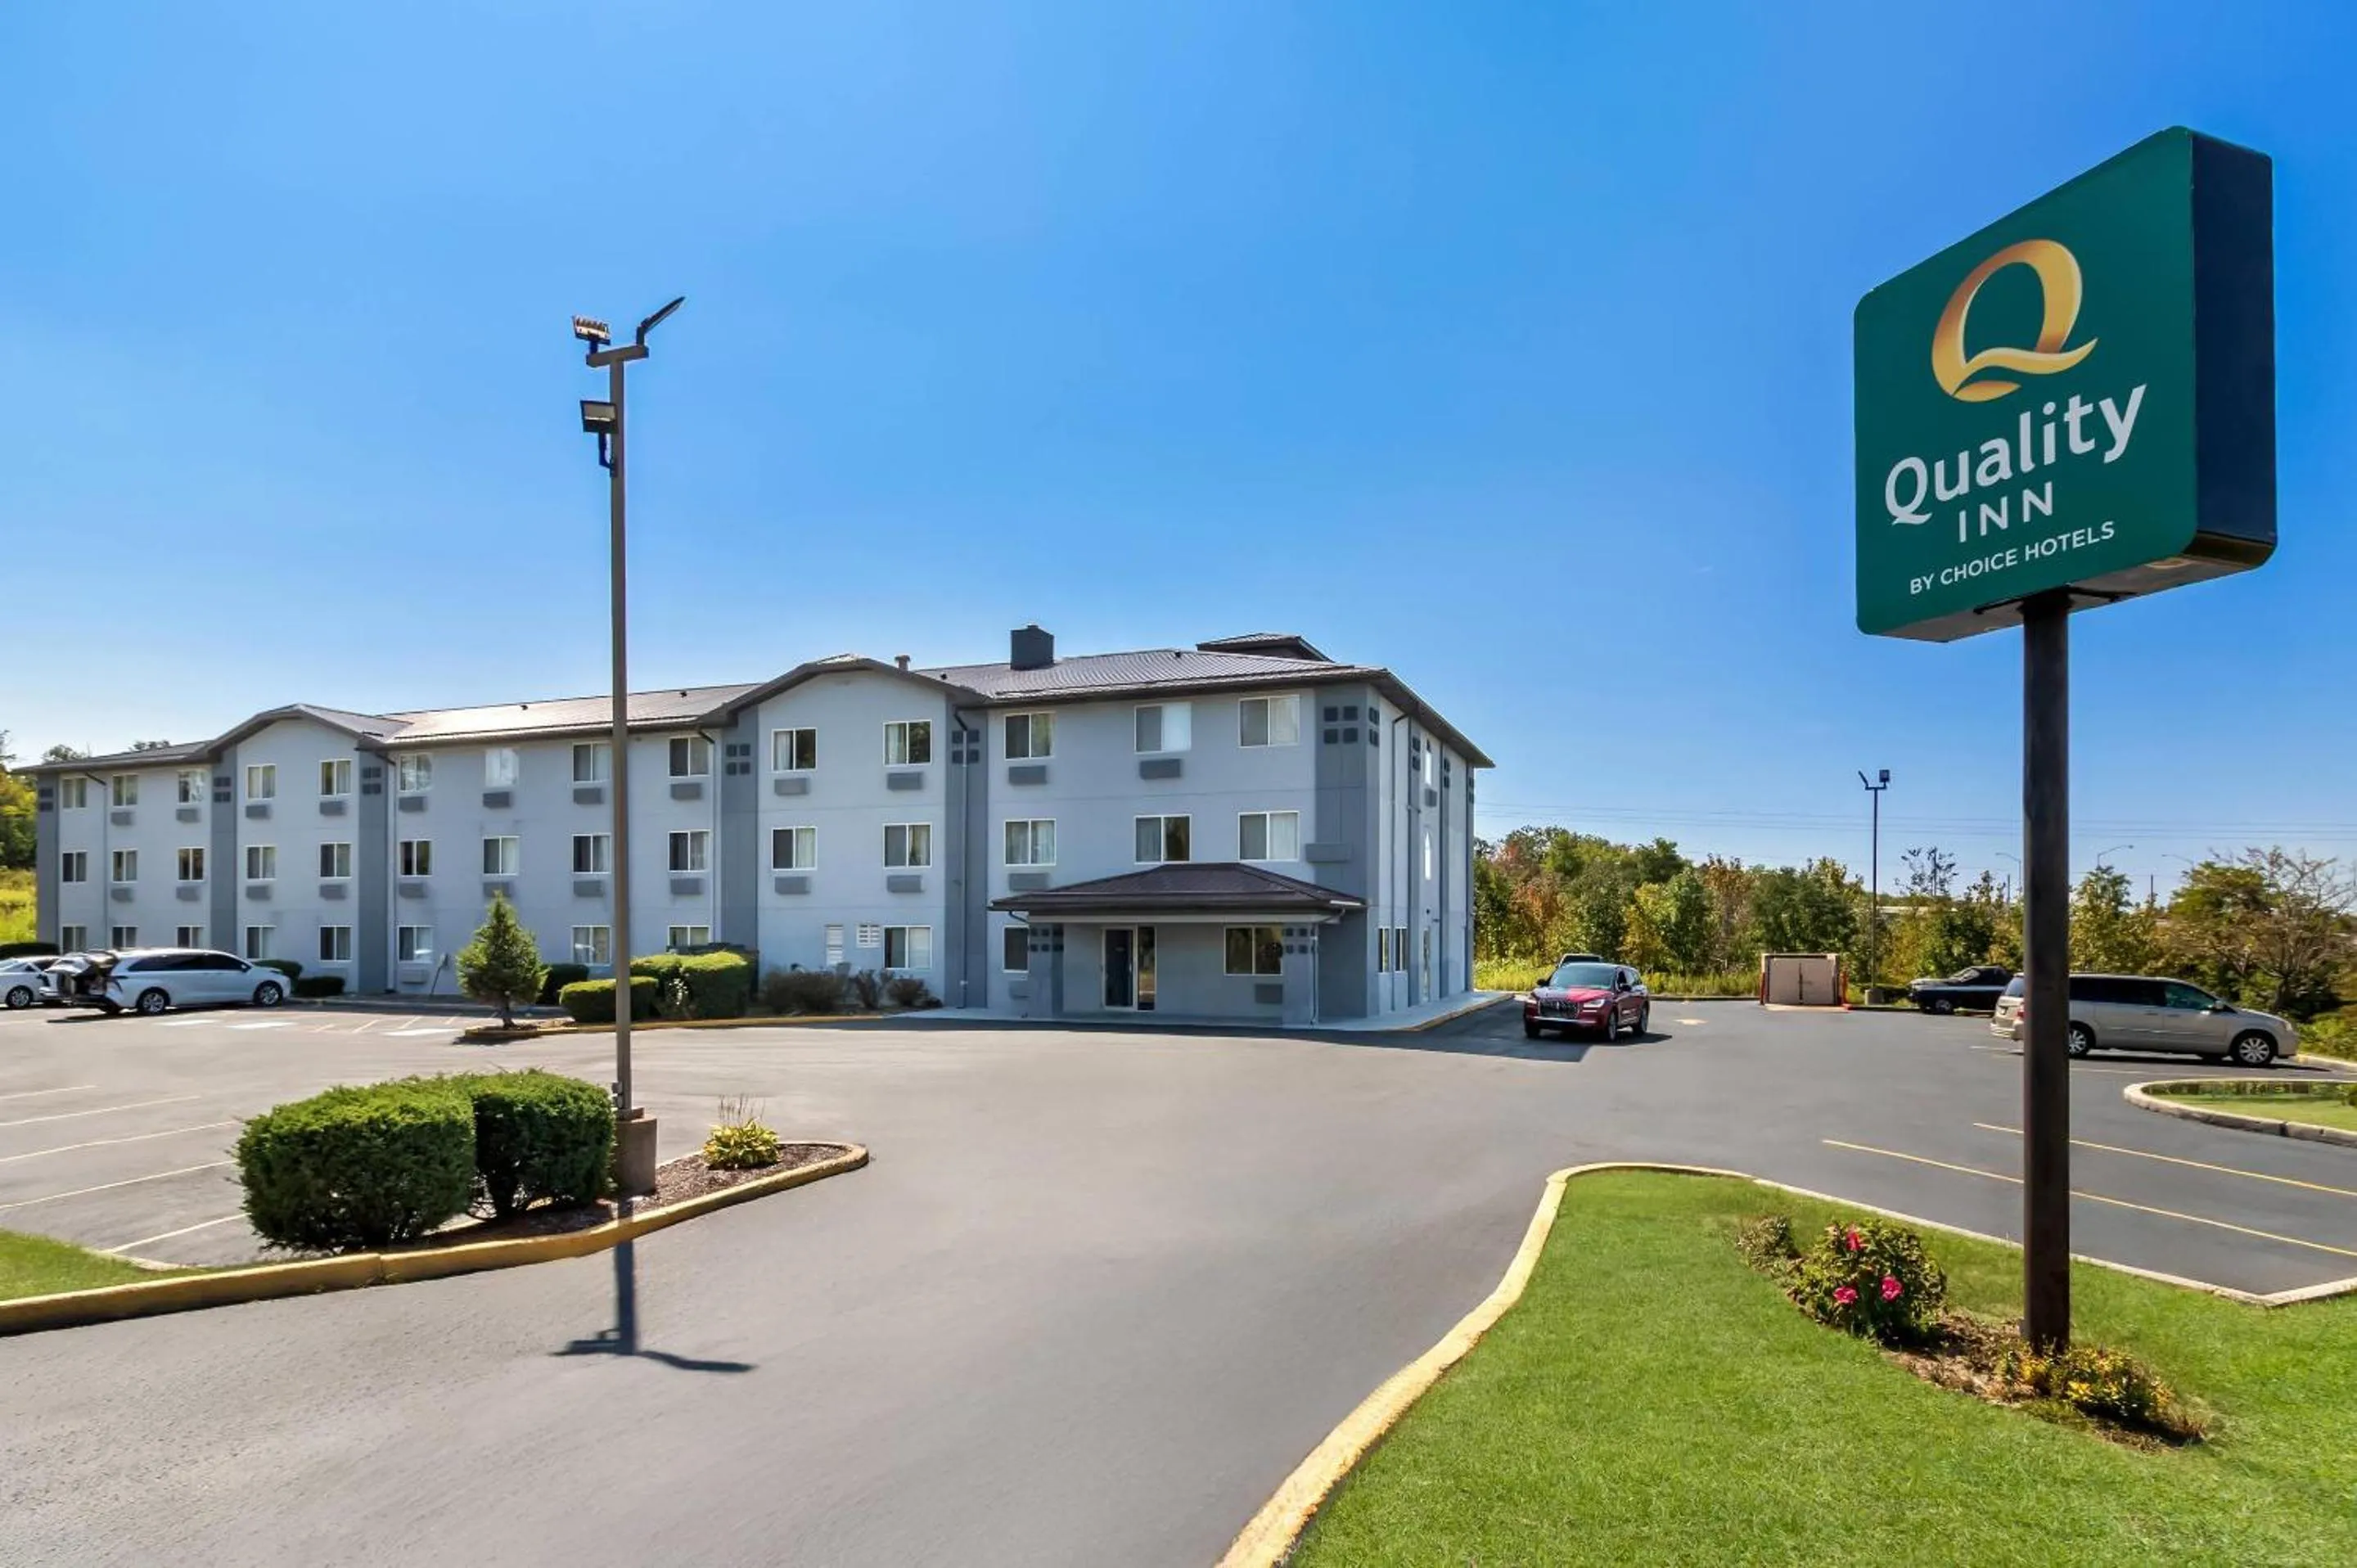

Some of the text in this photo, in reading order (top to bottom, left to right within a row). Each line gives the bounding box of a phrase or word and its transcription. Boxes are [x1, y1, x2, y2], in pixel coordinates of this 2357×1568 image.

[1932, 239, 2098, 402] Q
[1885, 384, 2147, 525] Quality
[1910, 520, 2115, 594] BY CHOICE HOTELS
[1959, 481, 2053, 543] INN
